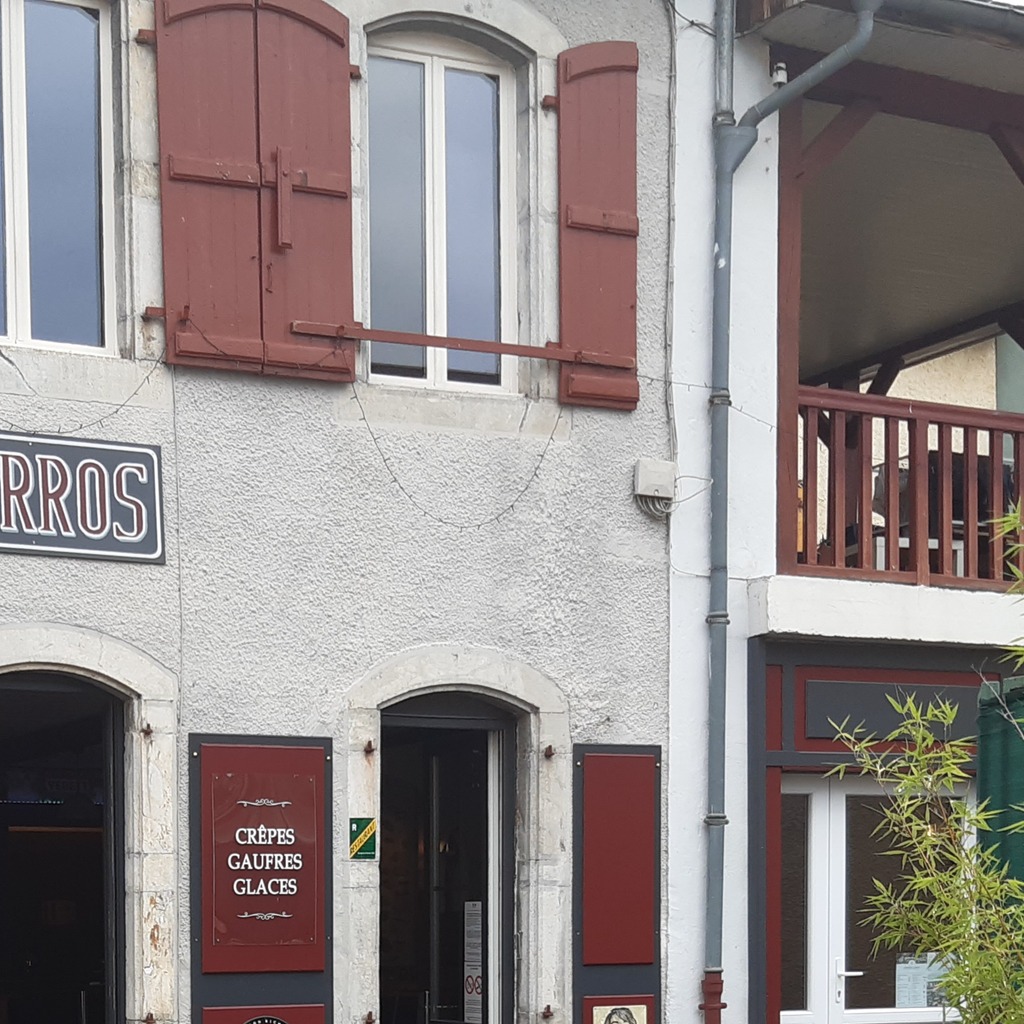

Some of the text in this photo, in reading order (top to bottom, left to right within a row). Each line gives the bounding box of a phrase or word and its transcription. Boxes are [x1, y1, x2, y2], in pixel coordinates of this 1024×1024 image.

[235, 824, 295, 845] CRÊPES
[227, 853, 303, 870] GAUFRES
[233, 878, 298, 895] GLACES
